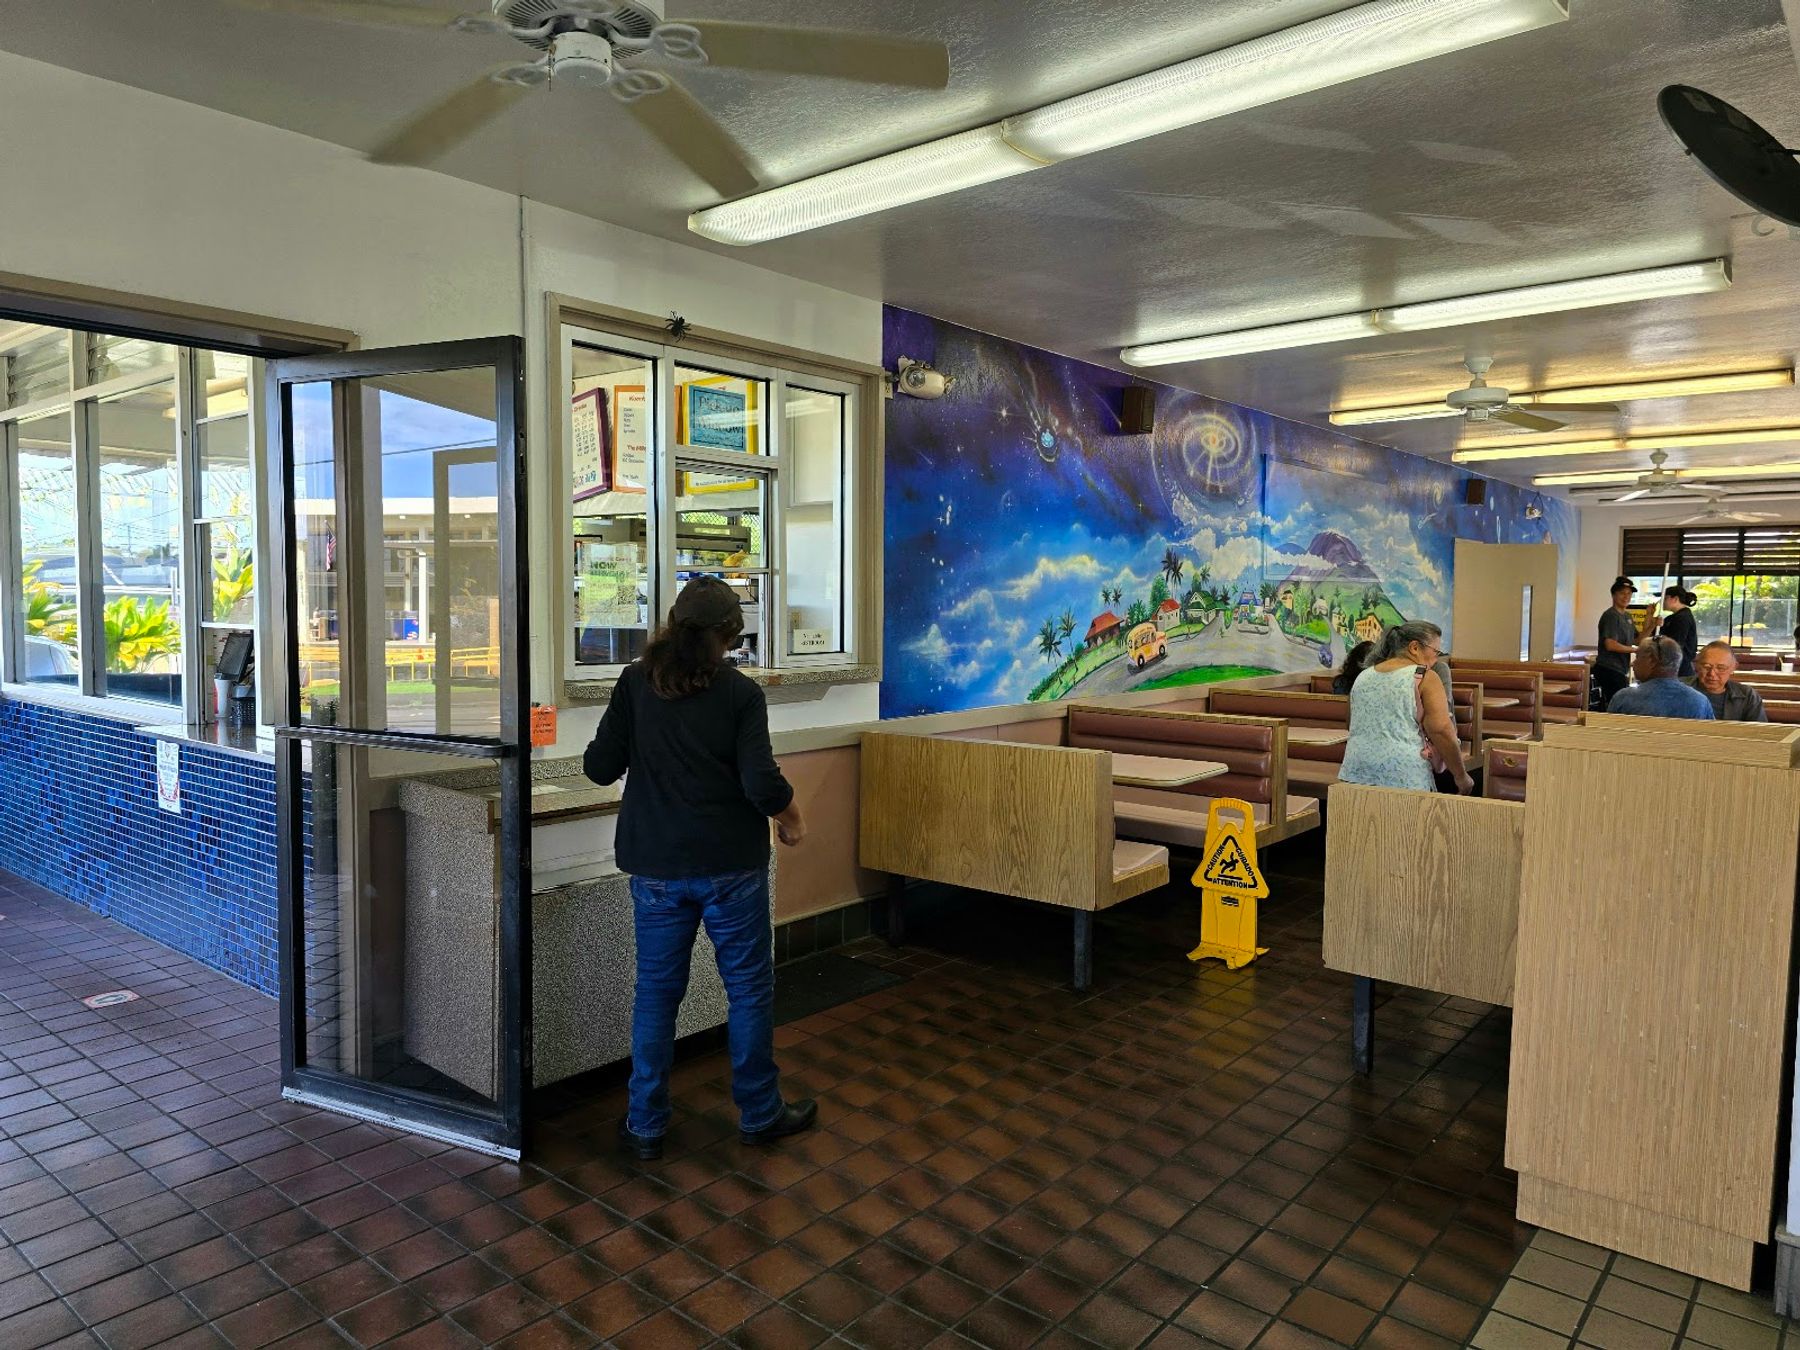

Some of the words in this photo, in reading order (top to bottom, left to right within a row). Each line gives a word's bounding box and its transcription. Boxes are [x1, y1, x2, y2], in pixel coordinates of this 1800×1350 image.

[590, 561, 618, 570] NOW
[1207, 844, 1226, 871] CAUTION
[1235, 847, 1255, 877] CUIDADO
[1212, 877, 1249, 889] ATTENTION
